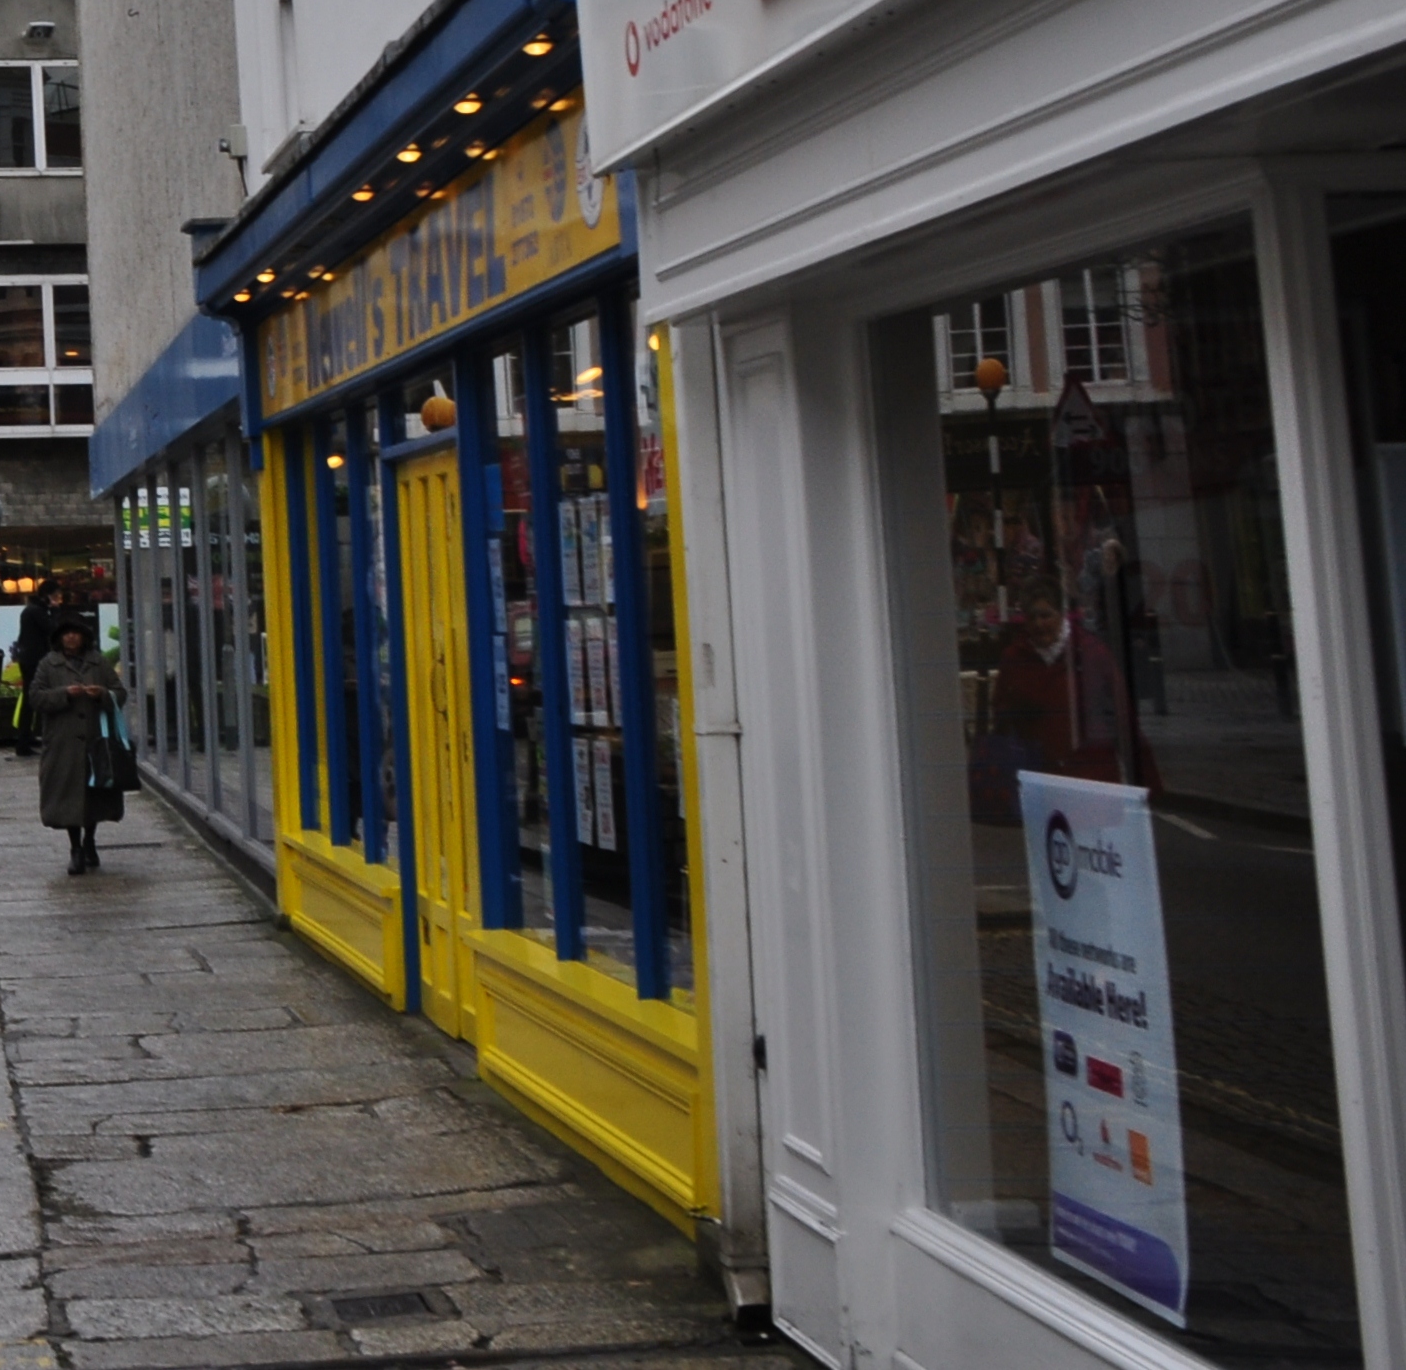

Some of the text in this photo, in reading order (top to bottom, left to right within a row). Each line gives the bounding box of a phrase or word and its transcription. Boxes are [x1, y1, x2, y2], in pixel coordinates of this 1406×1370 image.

[390, 171, 508, 348] TRAVEL
[1047, 962, 1149, 1030] Available Here!
